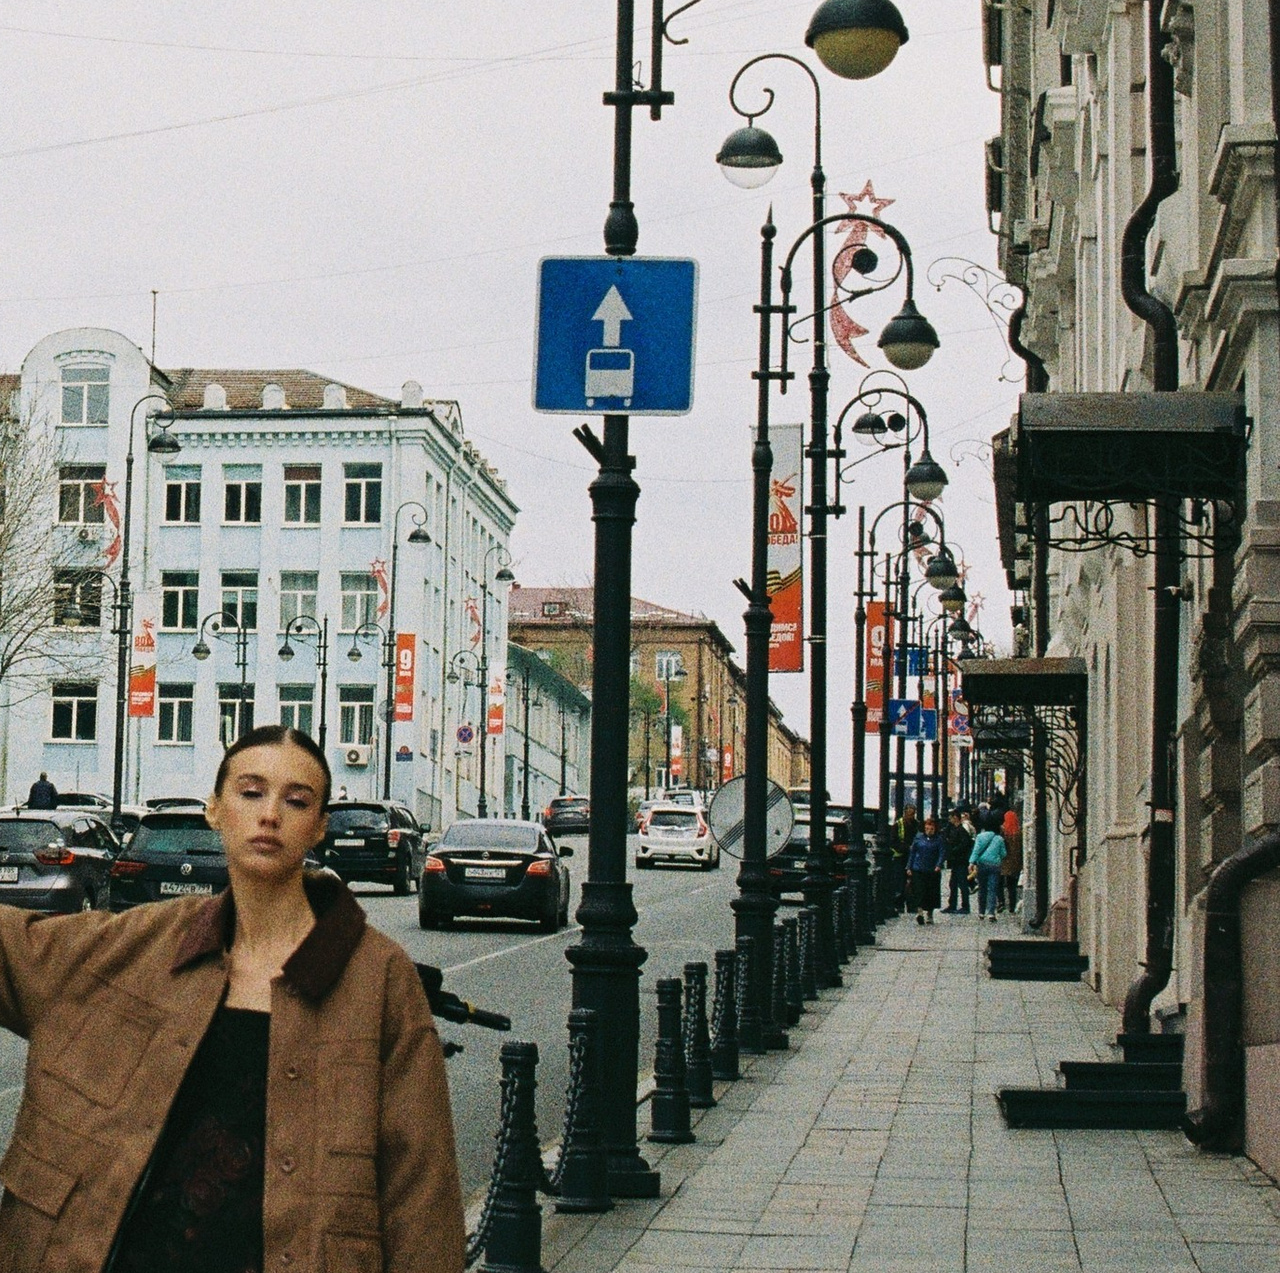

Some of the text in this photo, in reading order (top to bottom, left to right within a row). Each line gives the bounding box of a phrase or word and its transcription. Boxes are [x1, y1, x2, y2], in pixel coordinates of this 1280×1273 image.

[767, 534, 798, 546] БЕДА!
[871, 625, 886, 657] 9
[400, 649, 412, 670] 9
[870, 658, 884, 667] МА
